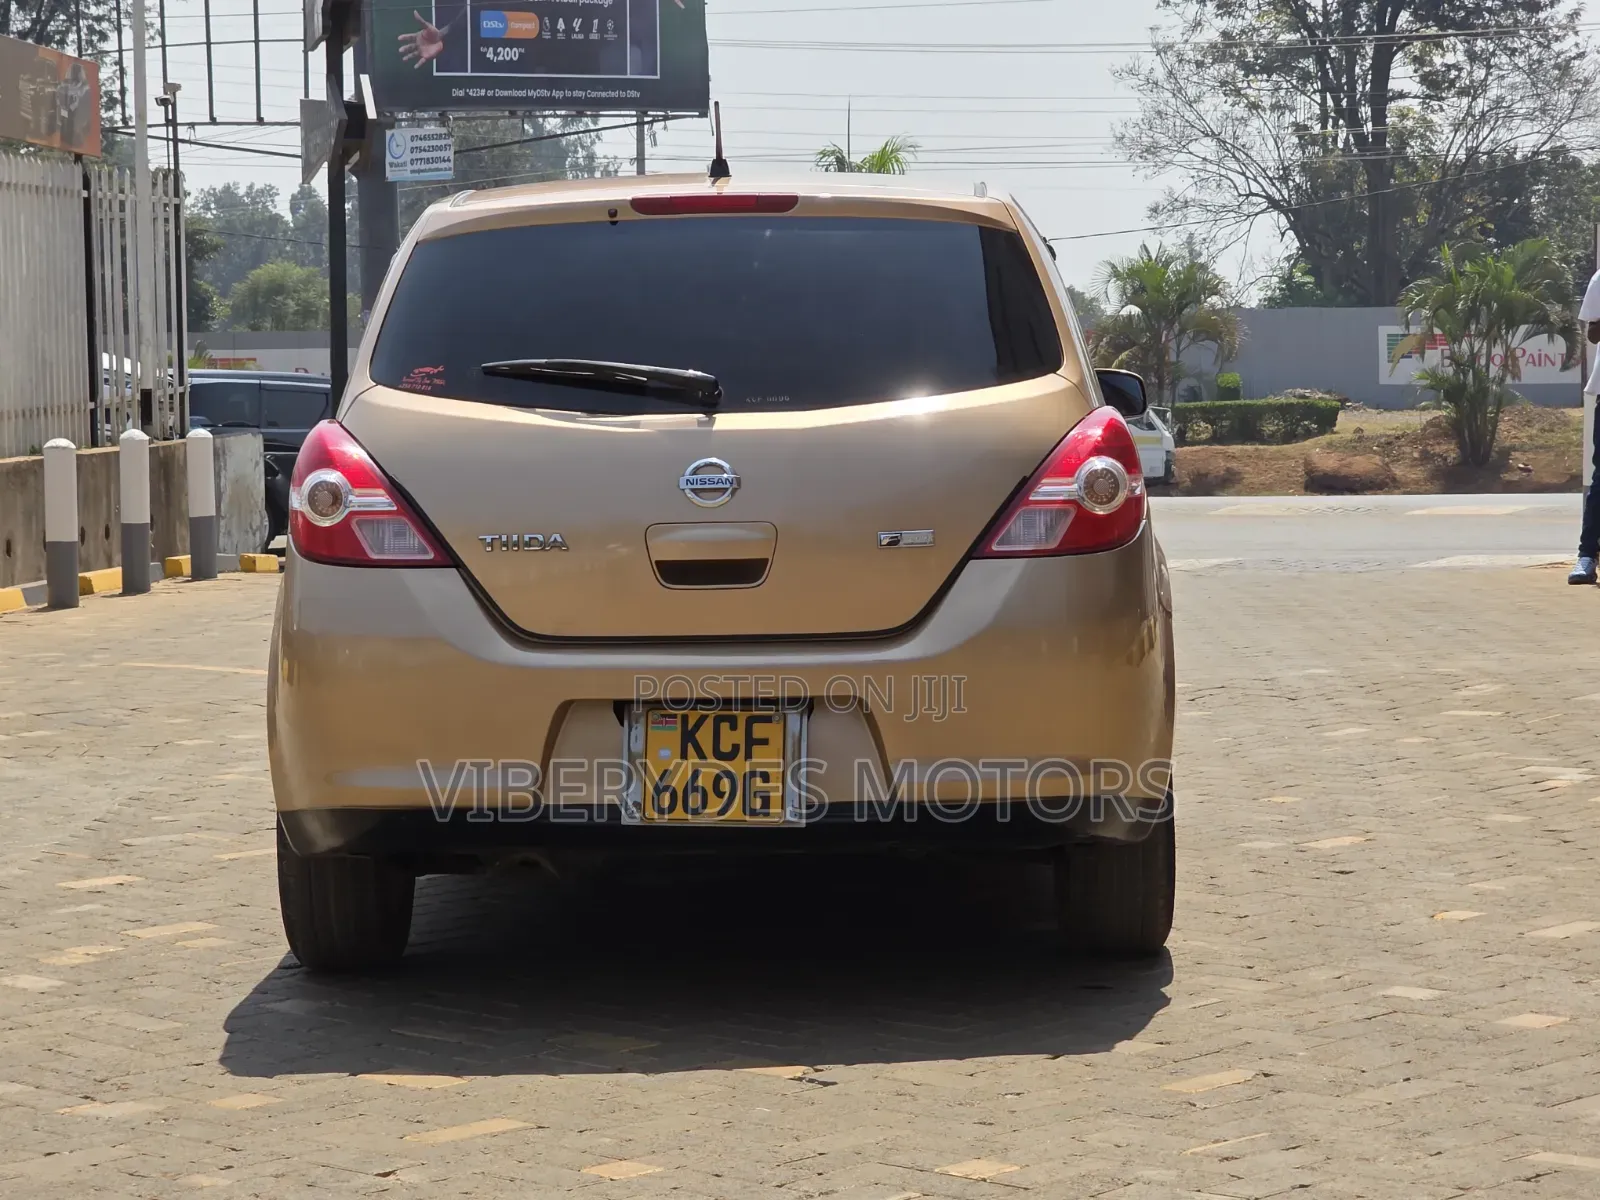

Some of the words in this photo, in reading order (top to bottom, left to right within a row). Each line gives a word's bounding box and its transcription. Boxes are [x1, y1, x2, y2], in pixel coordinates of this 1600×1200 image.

[510, 22, 536, 30] Compact
[486, 47, 519, 62] 4,200
[452, 88, 464, 97] Dial
[495, 89, 527, 97] Download
[527, 89, 550, 98] MyDStv
[552, 89, 564, 99] App
[565, 90, 571, 98] to
[573, 90, 585, 99] stay
[586, 90, 618, 98] Connected
[685, 477, 734, 487] NISSAN
[479, 533, 568, 552] TIIDA
[679, 713, 773, 762] KCF
[651, 768, 771, 817] 669G
